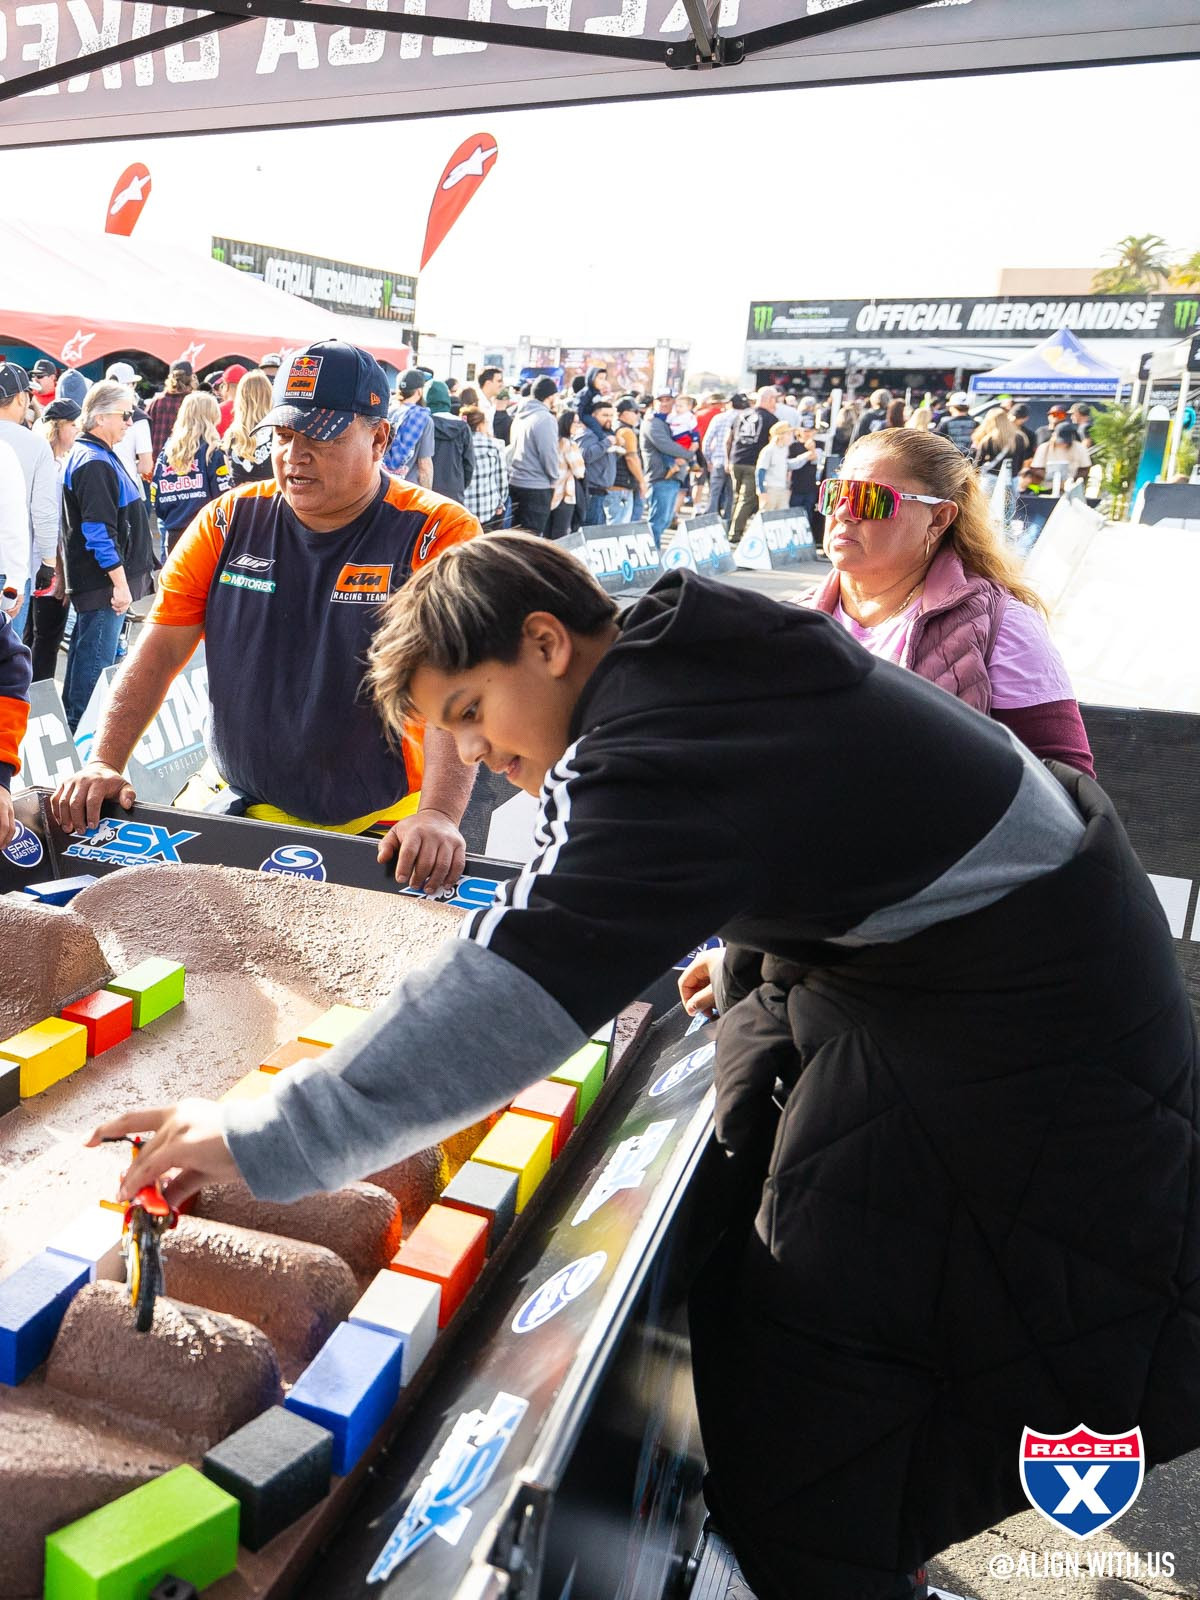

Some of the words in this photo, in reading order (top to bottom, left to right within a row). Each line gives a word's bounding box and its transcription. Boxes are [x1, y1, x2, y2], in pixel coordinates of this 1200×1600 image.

[855, 304, 963, 332] OFFICIAL
[966, 301, 1165, 331] MERCHANDISE
[159, 495, 177, 503] GIVES
[178, 493, 189, 501] YOU
[231, 574, 274, 592] MOTOREX
[344, 573, 383, 586] KTM
[333, 591, 362, 601] RACING
[366, 593, 387, 602] TEAM
[8, 838, 34, 853] SPIN
